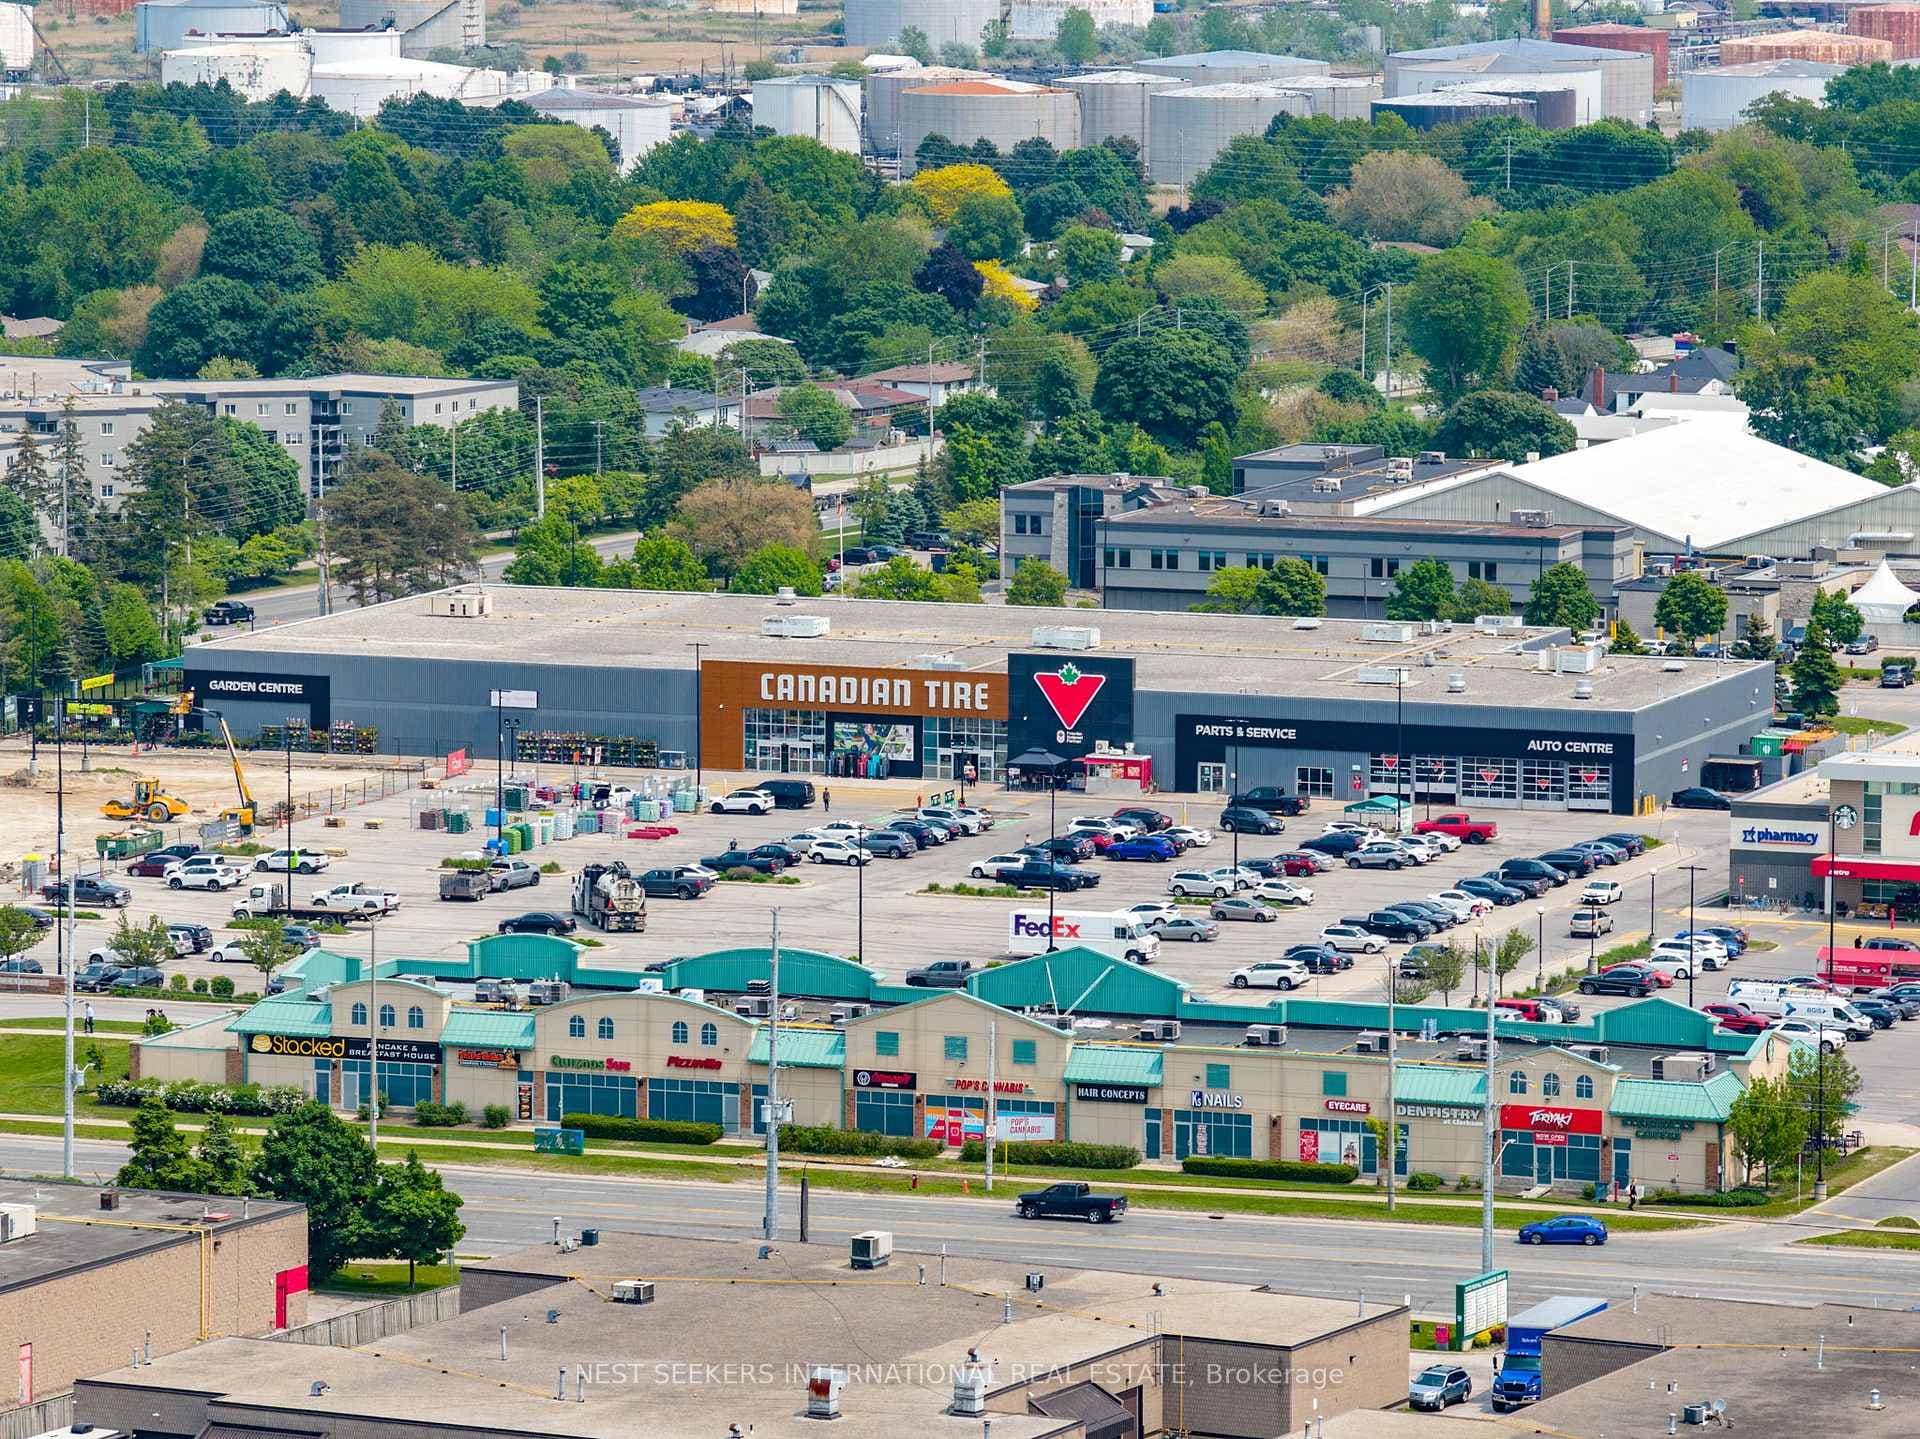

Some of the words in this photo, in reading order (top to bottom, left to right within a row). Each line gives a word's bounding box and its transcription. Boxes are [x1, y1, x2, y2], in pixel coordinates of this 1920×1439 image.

[209, 680, 256, 692] GARDEN
[258, 682, 303, 694] CENTRE
[760, 672, 911, 707] CANADIAN
[924, 680, 989, 711] TIRE
[1195, 725, 1234, 737] PARTS
[1236, 726, 1244, 737] &
[1246, 727, 1297, 740] SERVICE
[1527, 739, 1562, 752] AUTO
[1564, 741, 1614, 754] CENTRE
[1757, 828, 1819, 846] pharmacy
[1014, 914, 1081, 938] FedEx
[272, 1034, 345, 1057] Stacked
[367, 1043, 409, 1052] PNCAKE
[403, 1052, 436, 1060] HOUSE
[955, 1079, 980, 1092] POP'S
[1078, 1087, 1099, 1098] HAIR
[1101, 1089, 1146, 1100] CONCEPTS
[1203, 1094, 1243, 1108] NAILS
[1328, 1101, 1367, 1112] EYECARE
[1396, 1104, 1481, 1121] DENTISTRY
